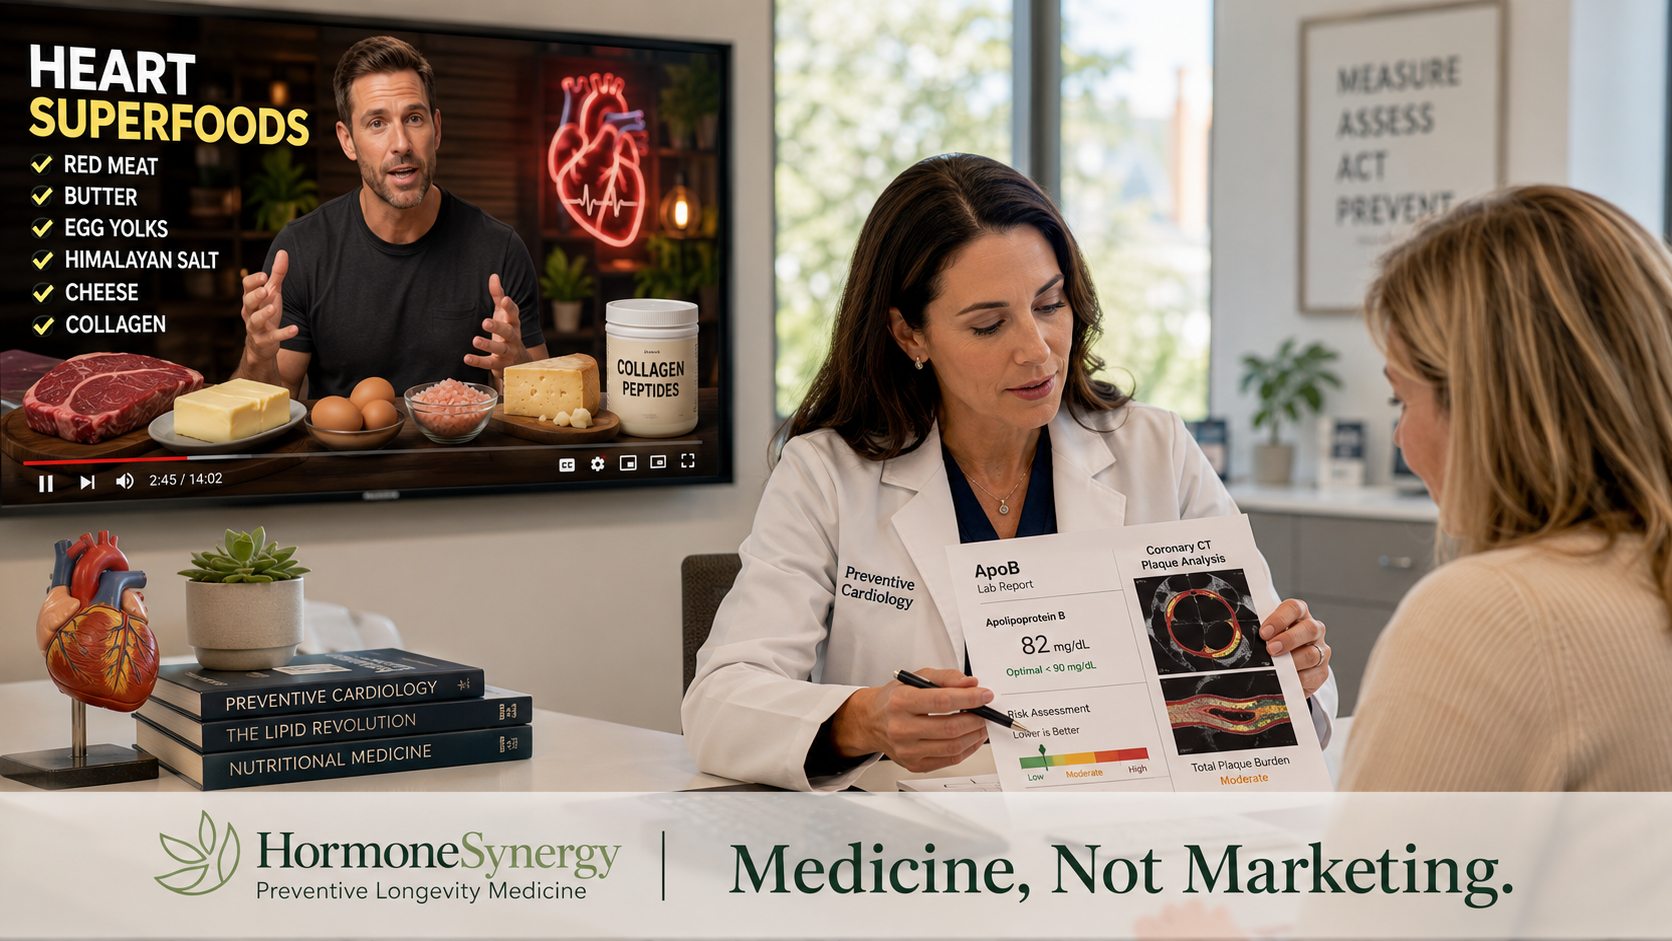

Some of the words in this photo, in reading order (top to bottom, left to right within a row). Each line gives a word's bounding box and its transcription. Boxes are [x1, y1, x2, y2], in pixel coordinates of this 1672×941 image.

[30, 44, 196, 95] HEART
[1337, 56, 1460, 94] MEASURE
[29, 96, 310, 147] SUPERFOODS
[1336, 103, 1434, 139] ASSESS
[64, 155, 102, 174] RED
[107, 156, 158, 176] MEAT
[1336, 151, 1387, 182] ACT
[64, 186, 138, 207] BUTTER
[64, 218, 104, 237] EGG
[109, 219, 169, 239] YOLKS
[65, 250, 173, 269] HIMALAYAN
[177, 251, 219, 269] SALT
[65, 282, 139, 302] CHEESE
[65, 315, 166, 334] COLLAGEN
[617, 358, 685, 378] COLLAGEN
[622, 380, 680, 398] PEPTIDES
[149, 473, 178, 486] 2:45
[179, 473, 187, 486] /
[188, 472, 223, 486] 14:02
[1146, 543, 1195, 555] Coronary
[1197, 540, 1211, 550] CT
[975, 560, 1021, 581] ApoB
[1141, 559, 1179, 570] Plaque
[1181, 553, 1226, 567] Analysis
[845, 565, 915, 591] Preventive
[977, 582, 997, 594] Lab
[999, 580, 1034, 592] Report
[841, 583, 914, 611] Cardiology
[985, 612, 1057, 628] Apolipoprotein
[1058, 611, 1066, 620] B
[1021, 634, 1051, 655] 82
[1053, 639, 1090, 654] mg/dL
[1006, 665, 1043, 678] Optimal
[1053, 663, 1065, 673] 90
[1067, 661, 1097, 673] mg/dL
[225, 690, 327, 712] PREVENTIVE
[331, 680, 437, 703] CARDIOLOGY
[1007, 708, 1029, 719] Risk
[1031, 704, 1091, 717] Assessment
[226, 725, 259, 743] THE
[264, 722, 307, 740] LIPID
[312, 712, 417, 736] REVOLUTION
[1012, 730, 1041, 740] Lower
[1042, 728, 1051, 737] is
[1052, 726, 1080, 736] Better
[229, 752, 346, 777] NUTRITIONAL
[351, 744, 432, 765] MEDICINE
[1191, 761, 1216, 773] Total
[1217, 759, 1252, 772] Plaque
[1254, 756, 1290, 768] Burden
[1027, 773, 1045, 782] Low
[1066, 769, 1104, 779] Moderate
[1128, 765, 1148, 775] High
[1220, 774, 1269, 785] Moderate
